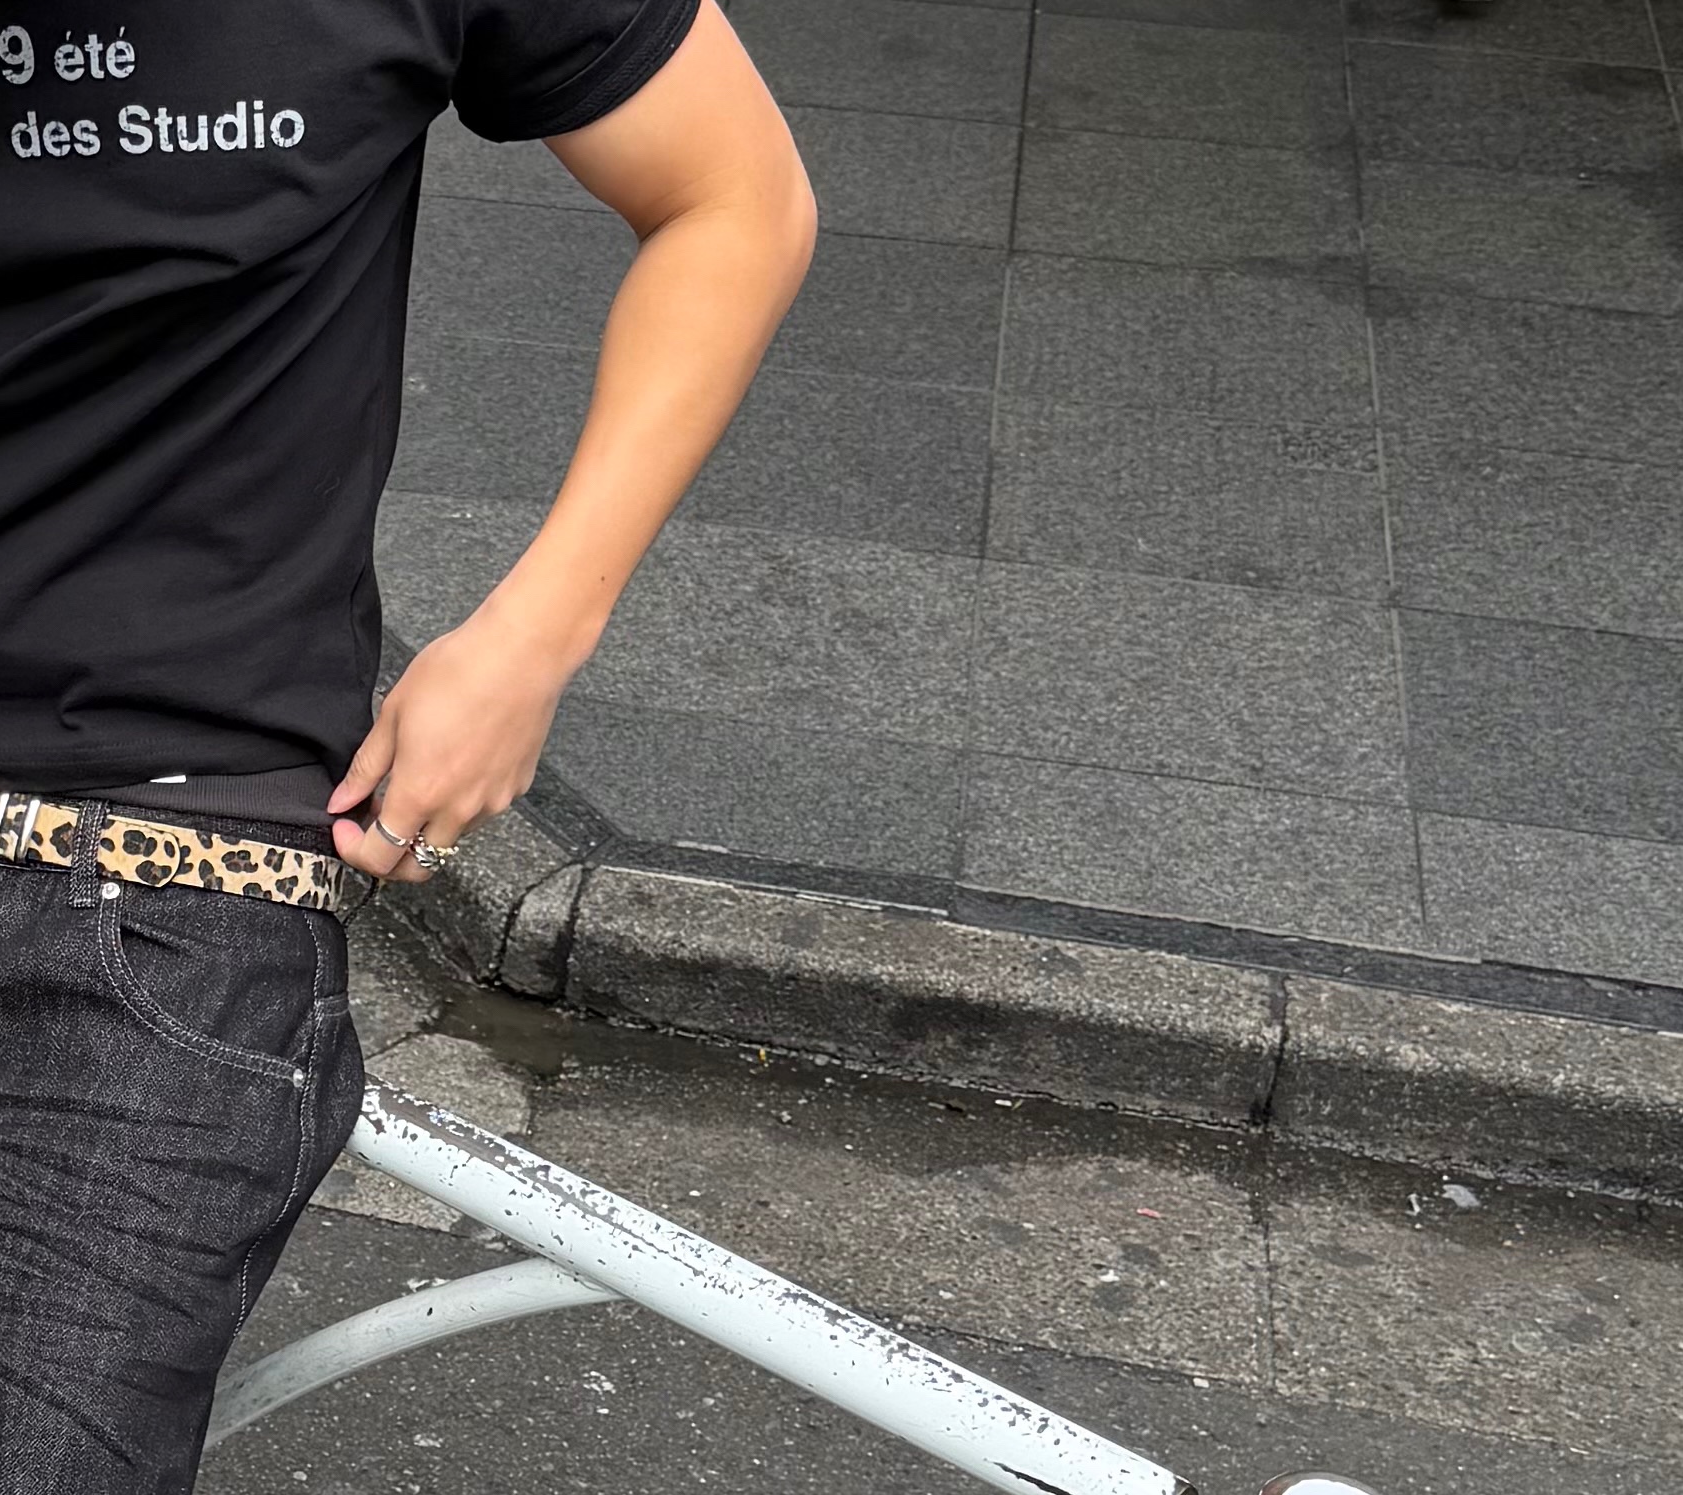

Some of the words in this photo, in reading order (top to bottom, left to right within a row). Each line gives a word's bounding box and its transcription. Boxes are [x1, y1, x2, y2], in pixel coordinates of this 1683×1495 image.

[54, 27, 136, 81] été
[11, 111, 102, 160] des
[118, 100, 305, 155] Studio
